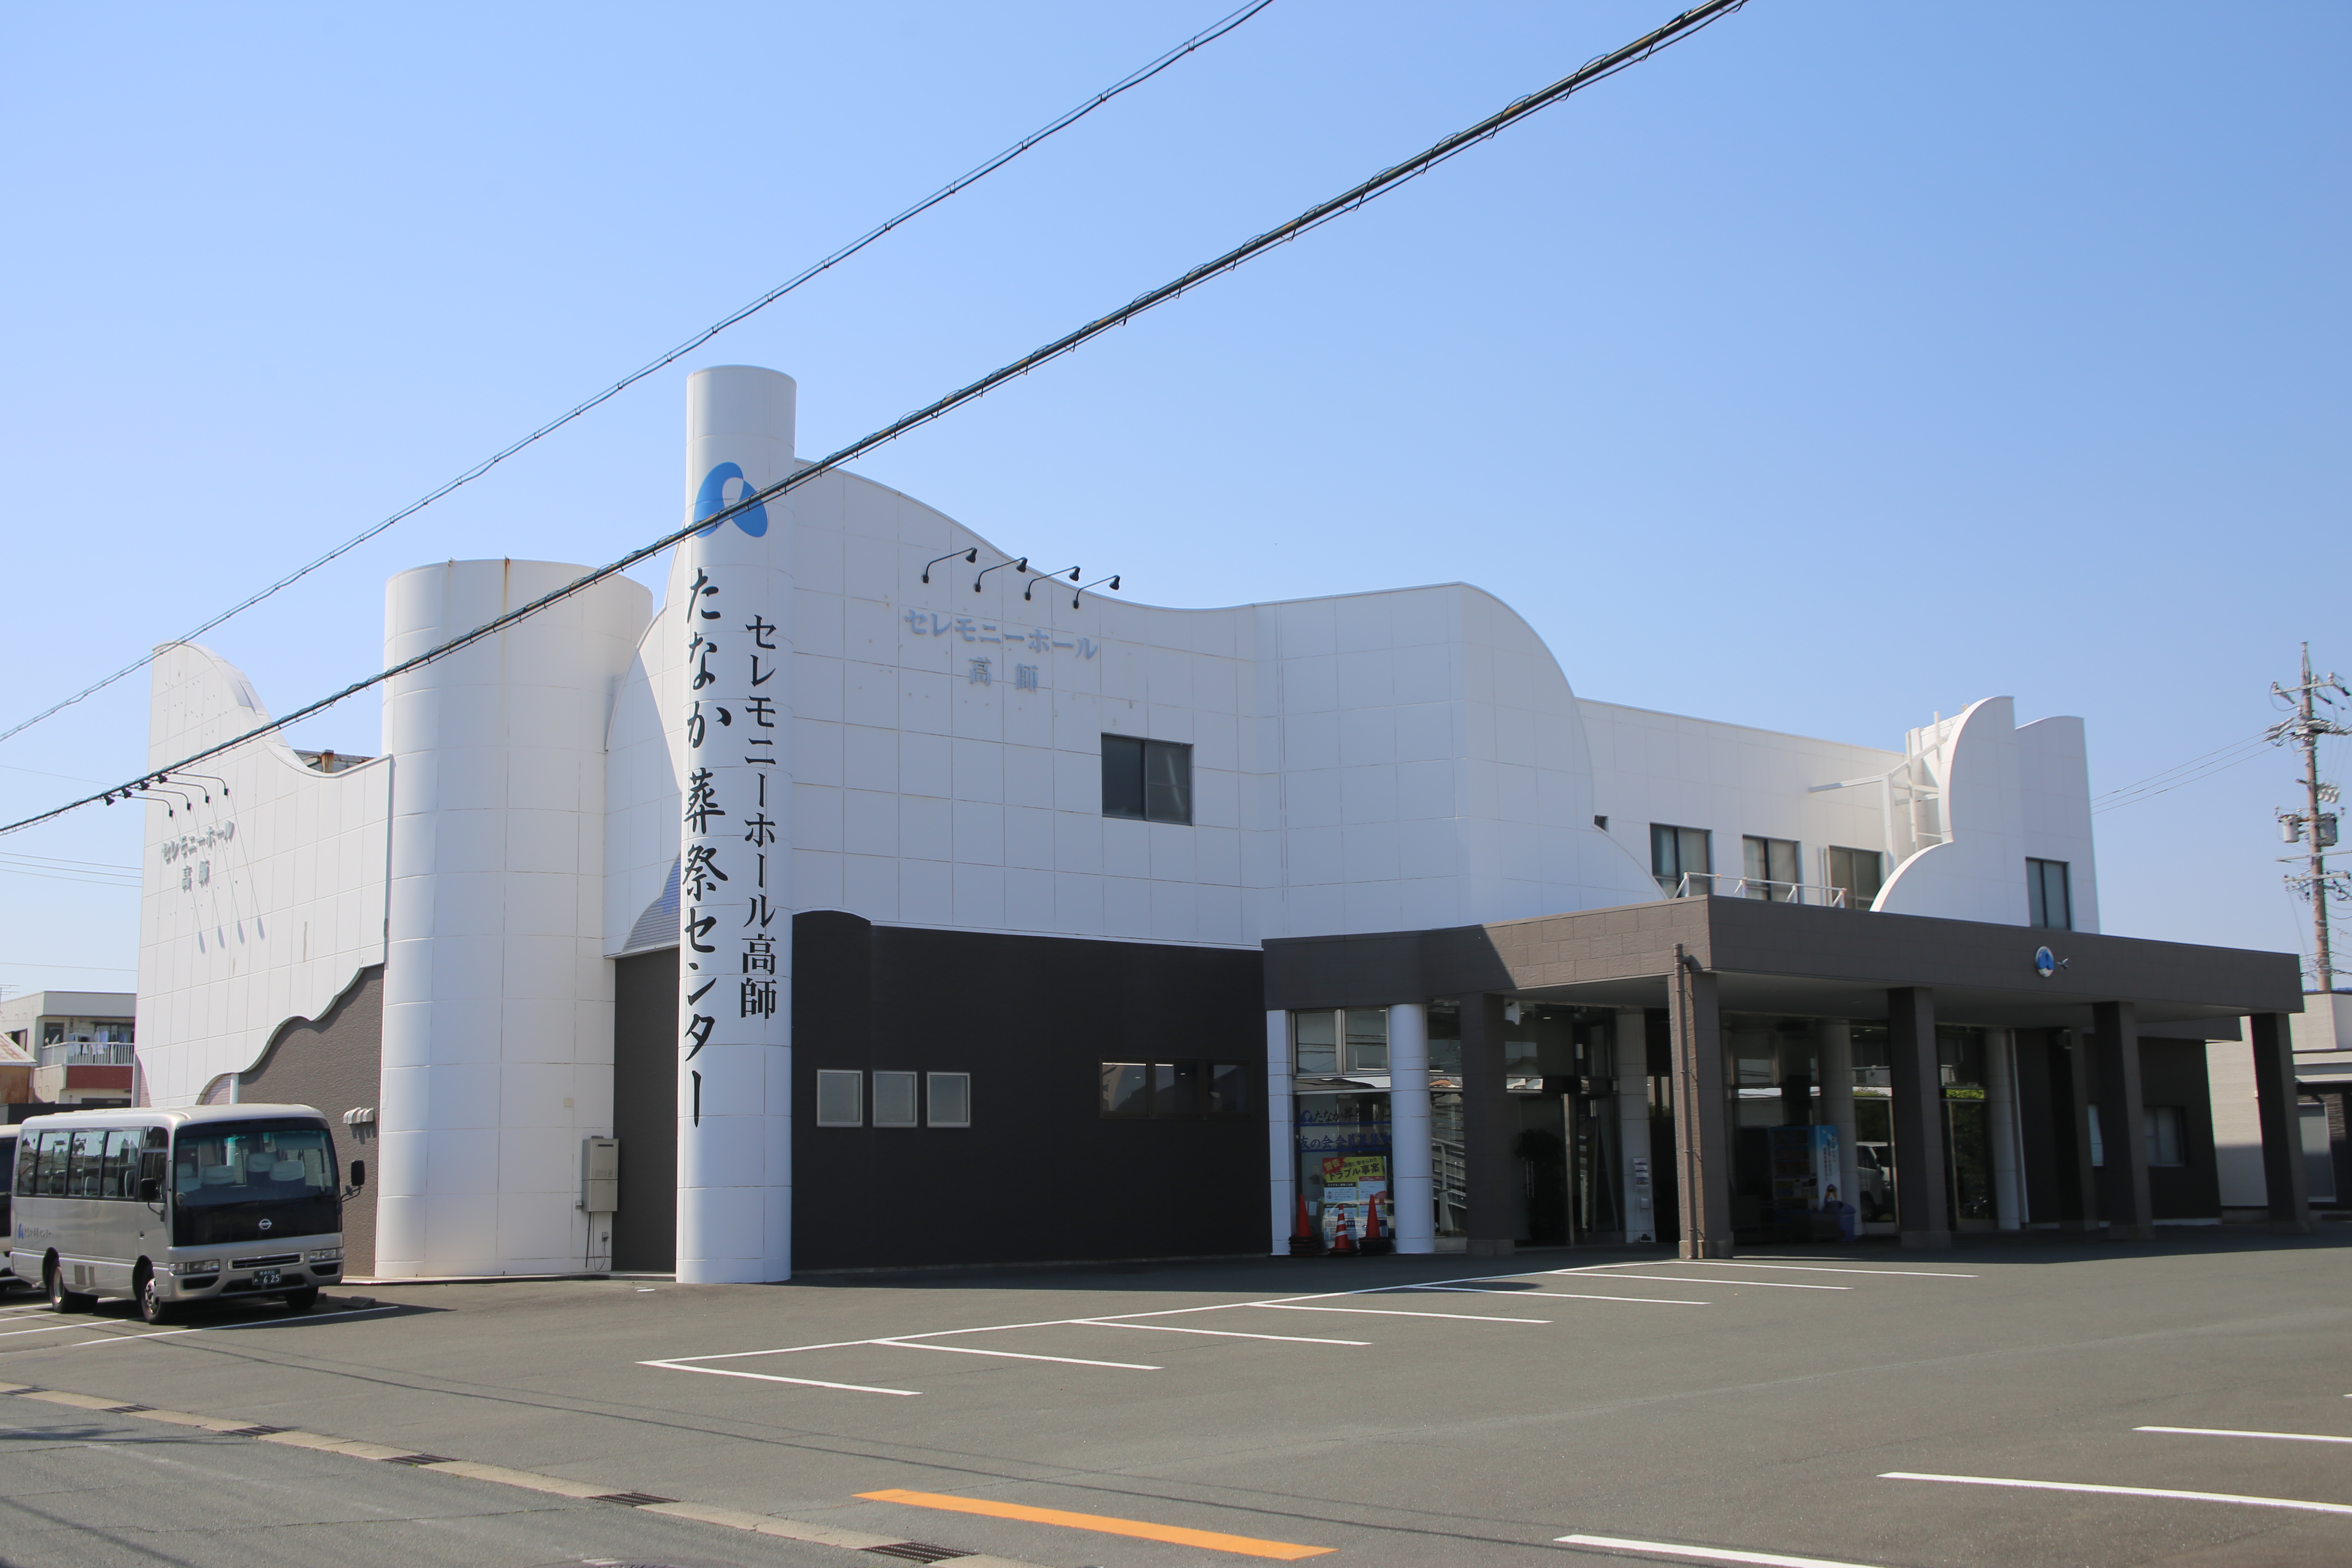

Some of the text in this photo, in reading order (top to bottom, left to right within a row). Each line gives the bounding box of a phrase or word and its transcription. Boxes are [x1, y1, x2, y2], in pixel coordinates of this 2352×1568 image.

[904, 609, 1098, 659] セレモニーホール
[741, 614, 777, 1020] セレモニーホール高師
[682, 567, 732, 1128] たなか葬祭センター
[1323, 1158, 1341, 1171] 警告
[1329, 1163, 1380, 1181] トラブル事案
